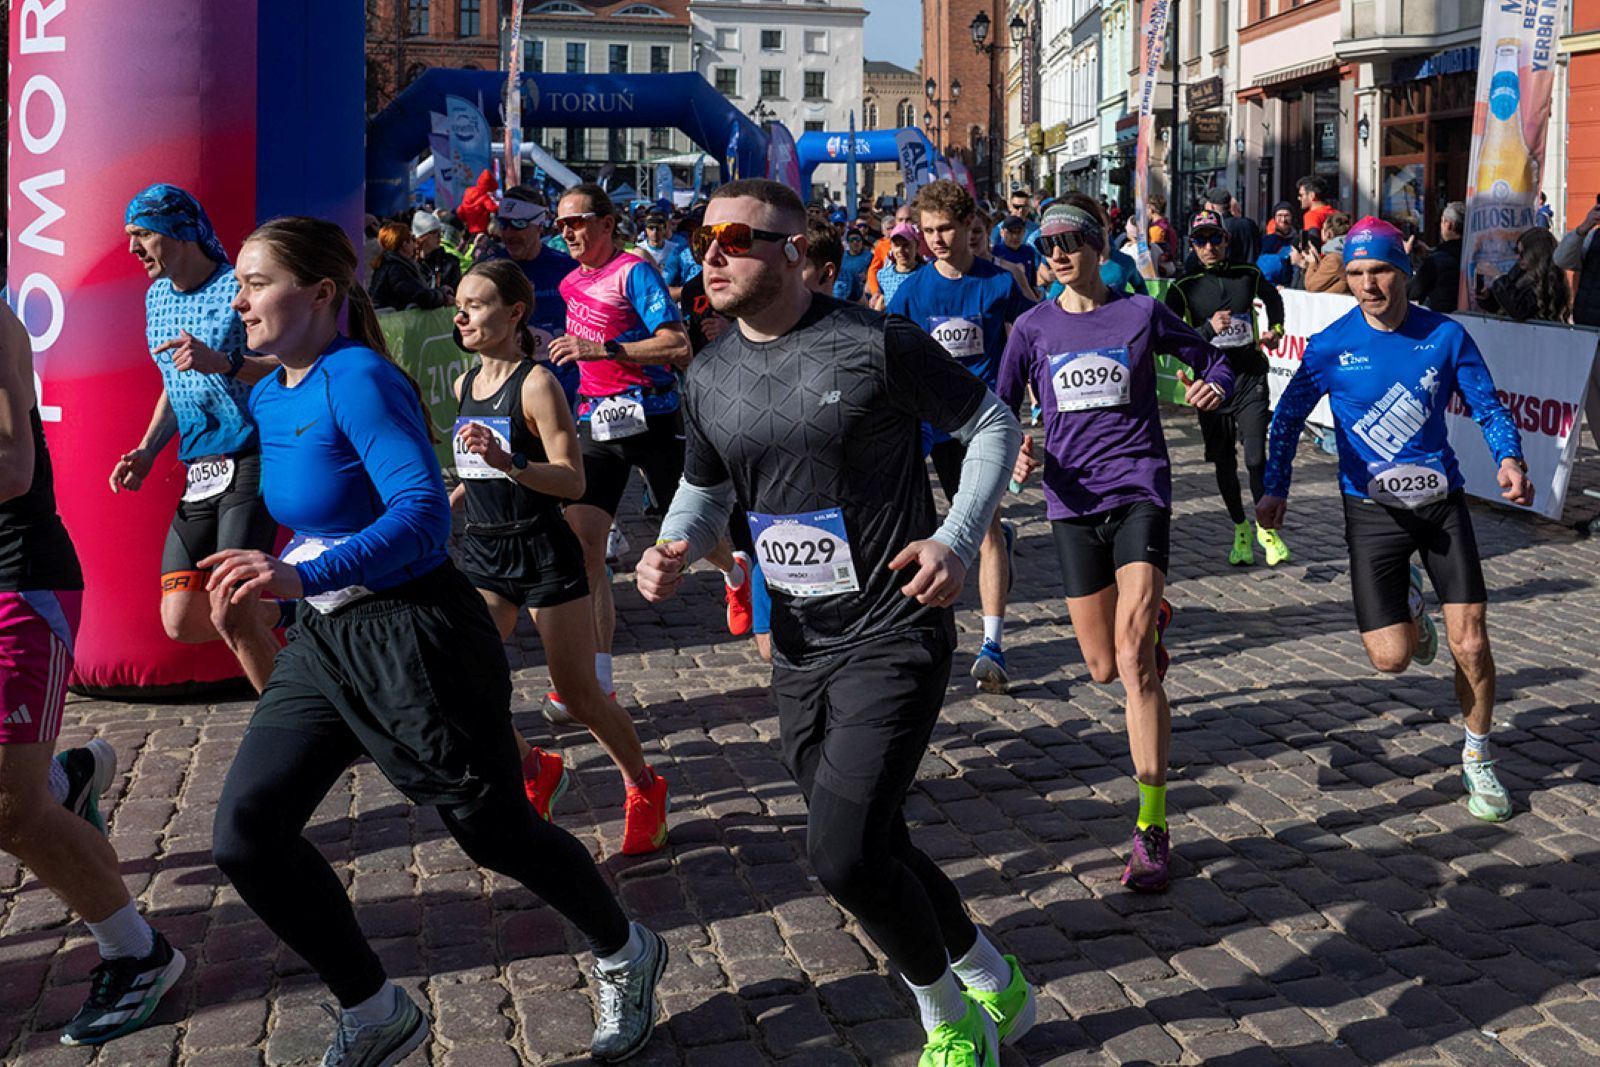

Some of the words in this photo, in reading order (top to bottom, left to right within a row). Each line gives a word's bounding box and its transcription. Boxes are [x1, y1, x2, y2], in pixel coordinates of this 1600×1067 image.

[1532, 15, 1555, 73] YERBA
[546, 87, 635, 112] TORUŃ
[936, 327, 979, 342] 10071
[1059, 365, 1122, 389] 10396
[596, 403, 638, 424] 10097
[190, 461, 229, 483] 10508
[1376, 473, 1439, 493] 10238
[760, 538, 836, 566] 10229
